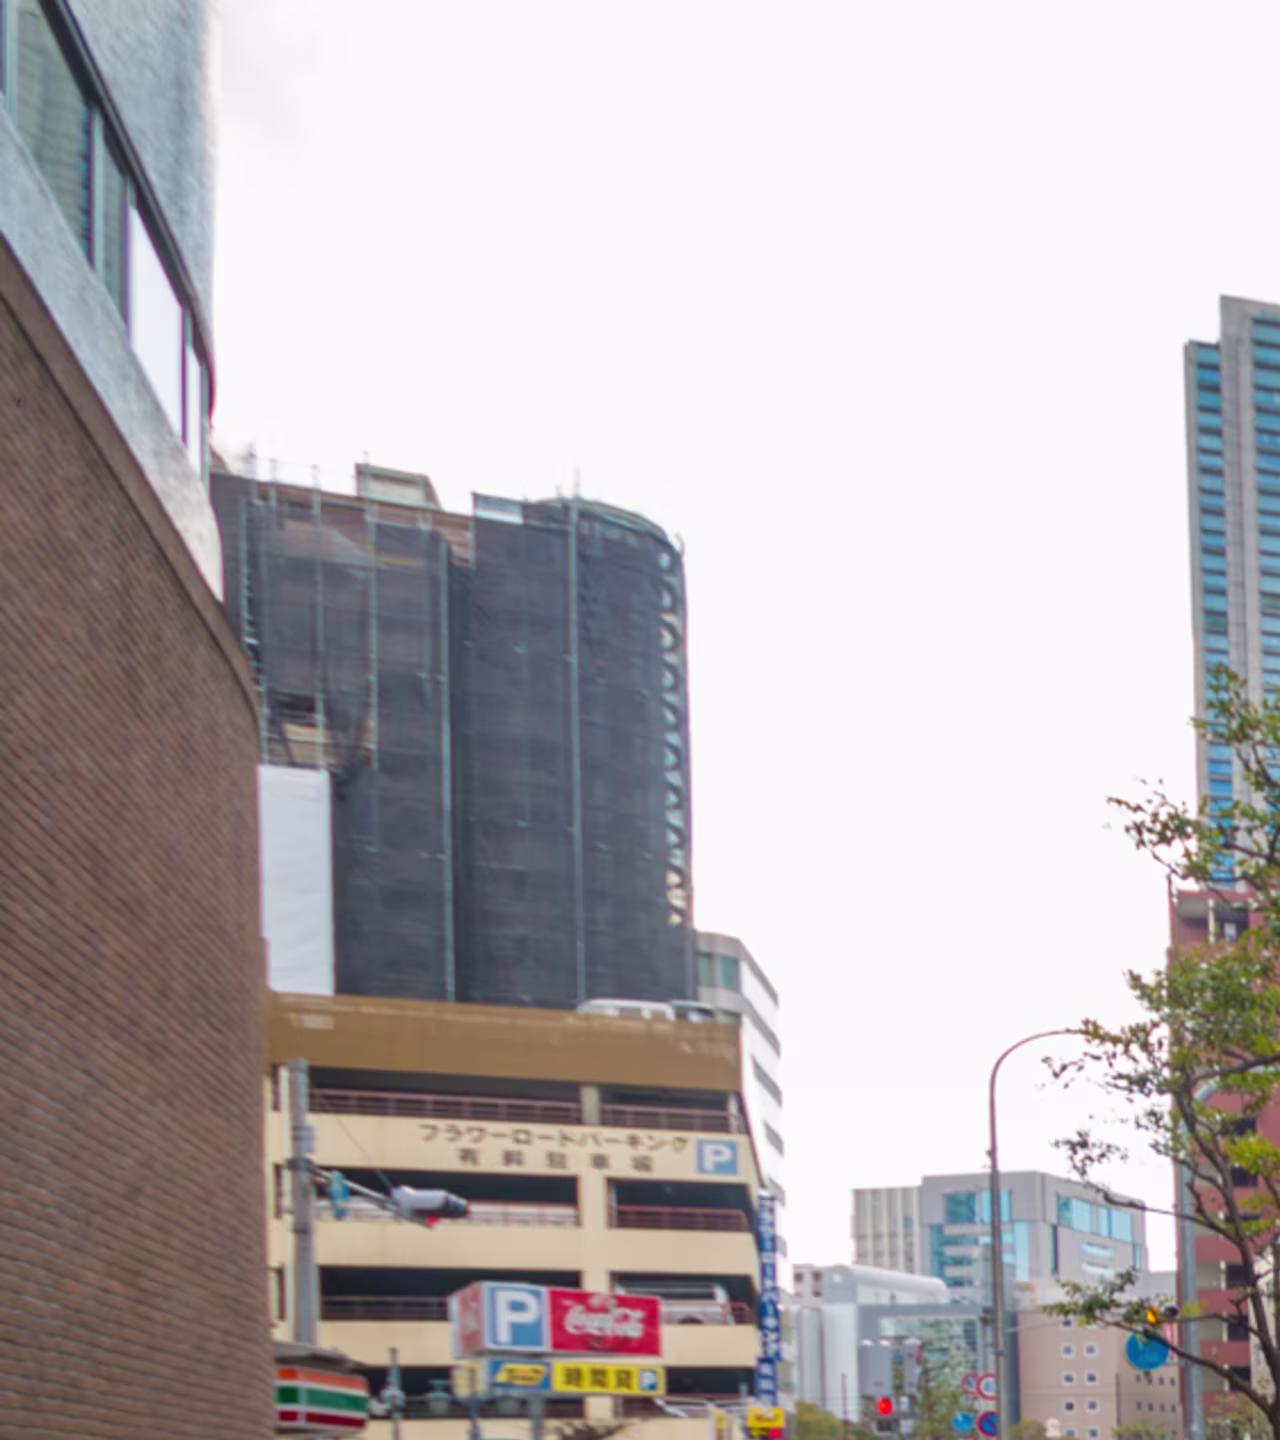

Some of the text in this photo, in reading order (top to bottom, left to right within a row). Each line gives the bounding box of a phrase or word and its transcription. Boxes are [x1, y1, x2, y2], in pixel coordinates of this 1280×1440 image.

[418, 1122, 690, 1152] フラワーロードパーキング
[702, 1143, 733, 1170] P
[495, 1290, 540, 1343] P
